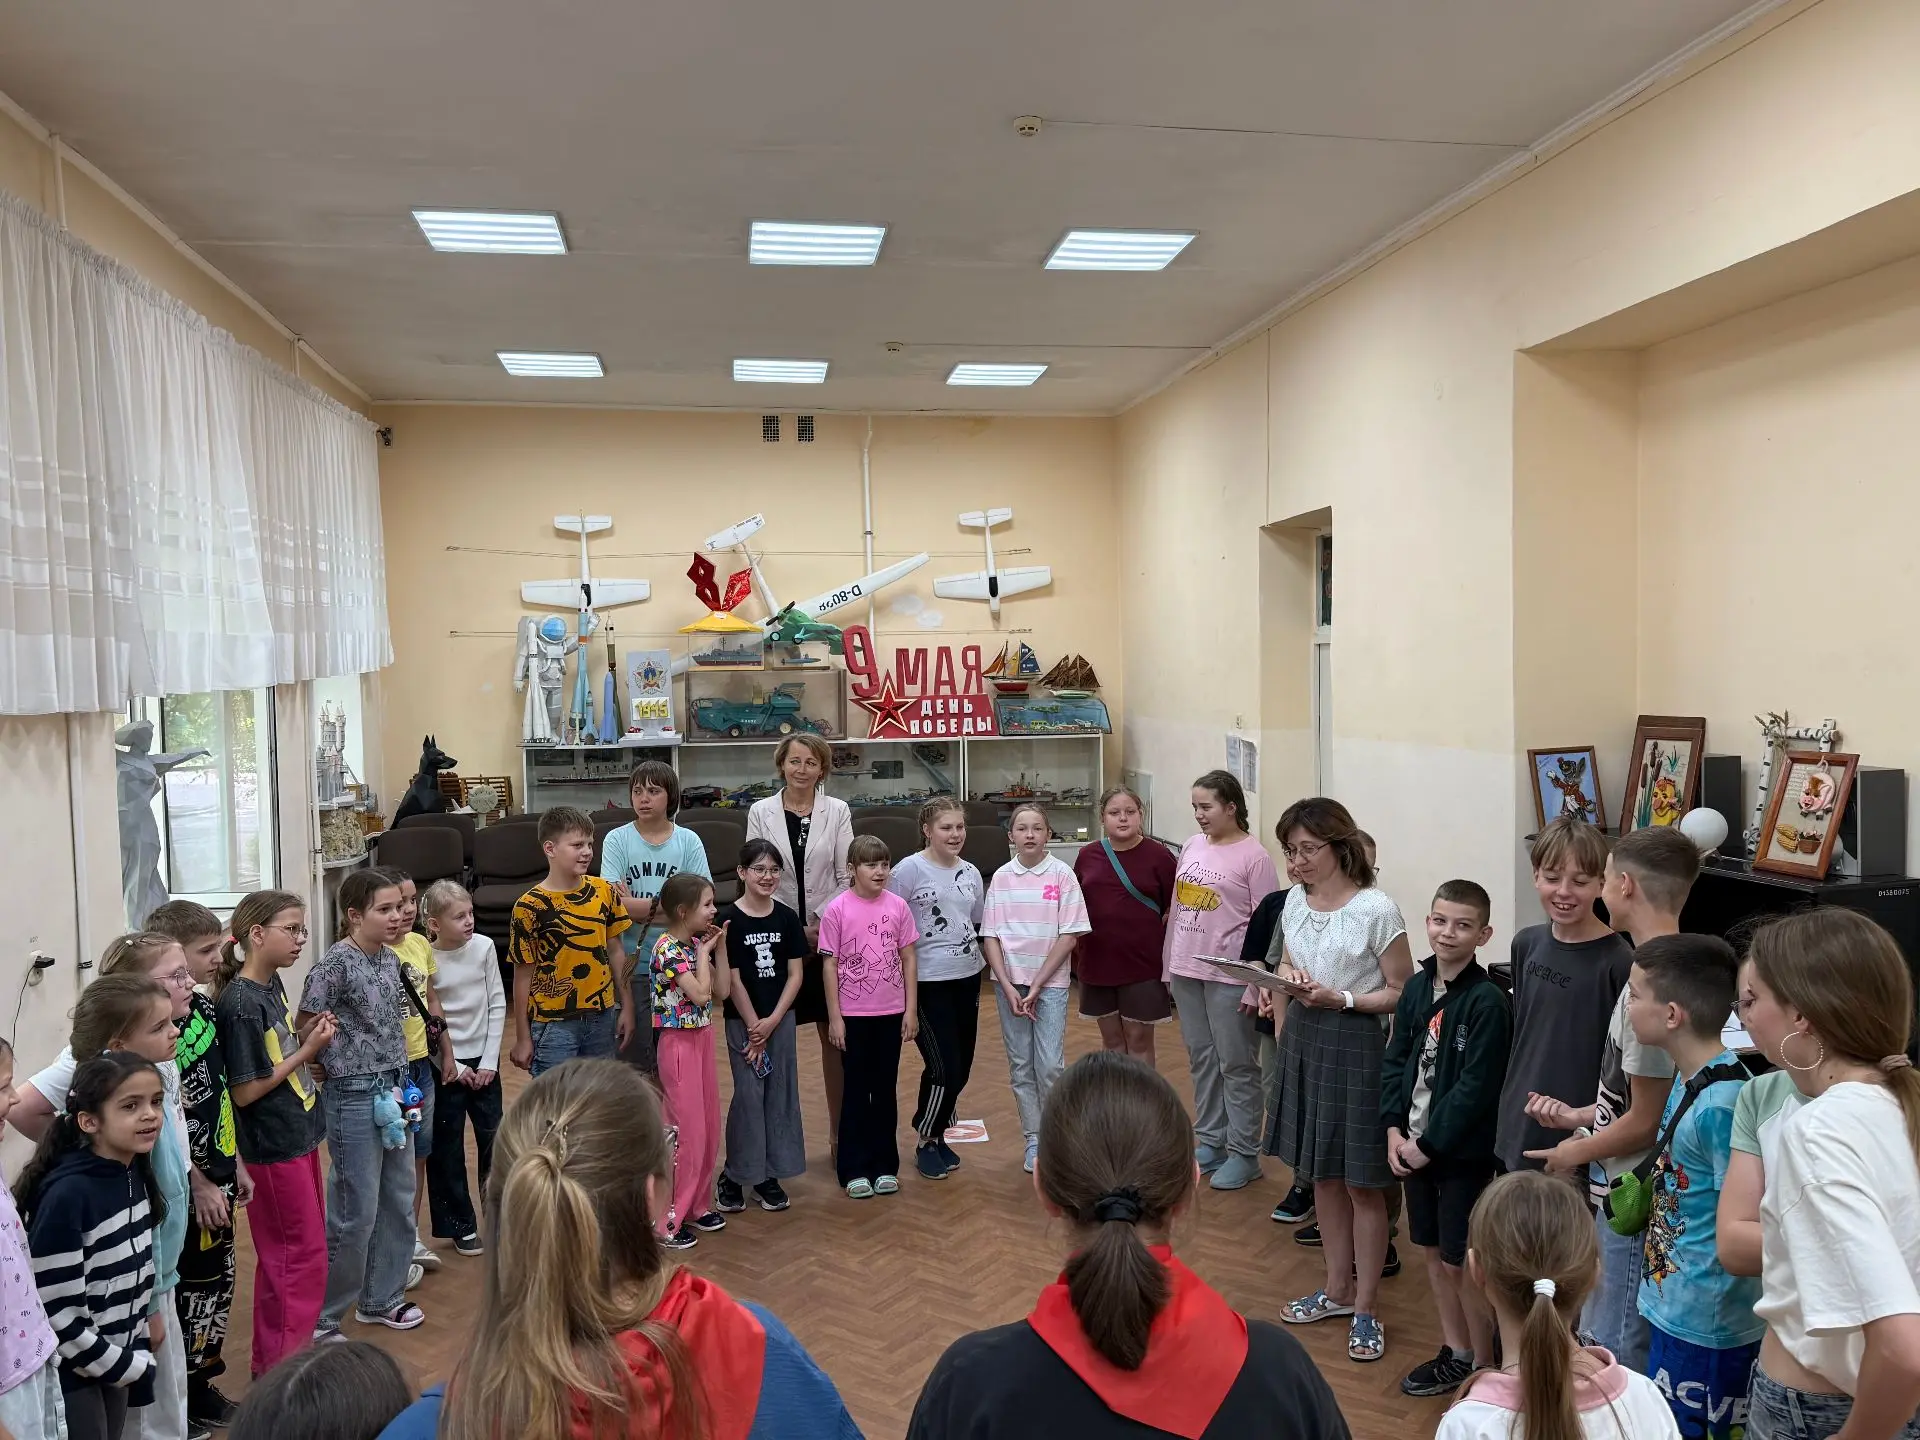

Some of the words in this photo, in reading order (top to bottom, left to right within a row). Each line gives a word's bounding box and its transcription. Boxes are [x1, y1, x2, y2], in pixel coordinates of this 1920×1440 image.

[842, 624, 881, 698] 9
[895, 644, 984, 697] МАЯ
[920, 698, 974, 717] ДЕНЬ
[909, 716, 992, 735] ПОБЕДЫ
[625, 861, 678, 886] SUMME
[743, 932, 769, 946] JUST
[769, 932, 782, 943] BE
[757, 967, 776, 978] YOU
